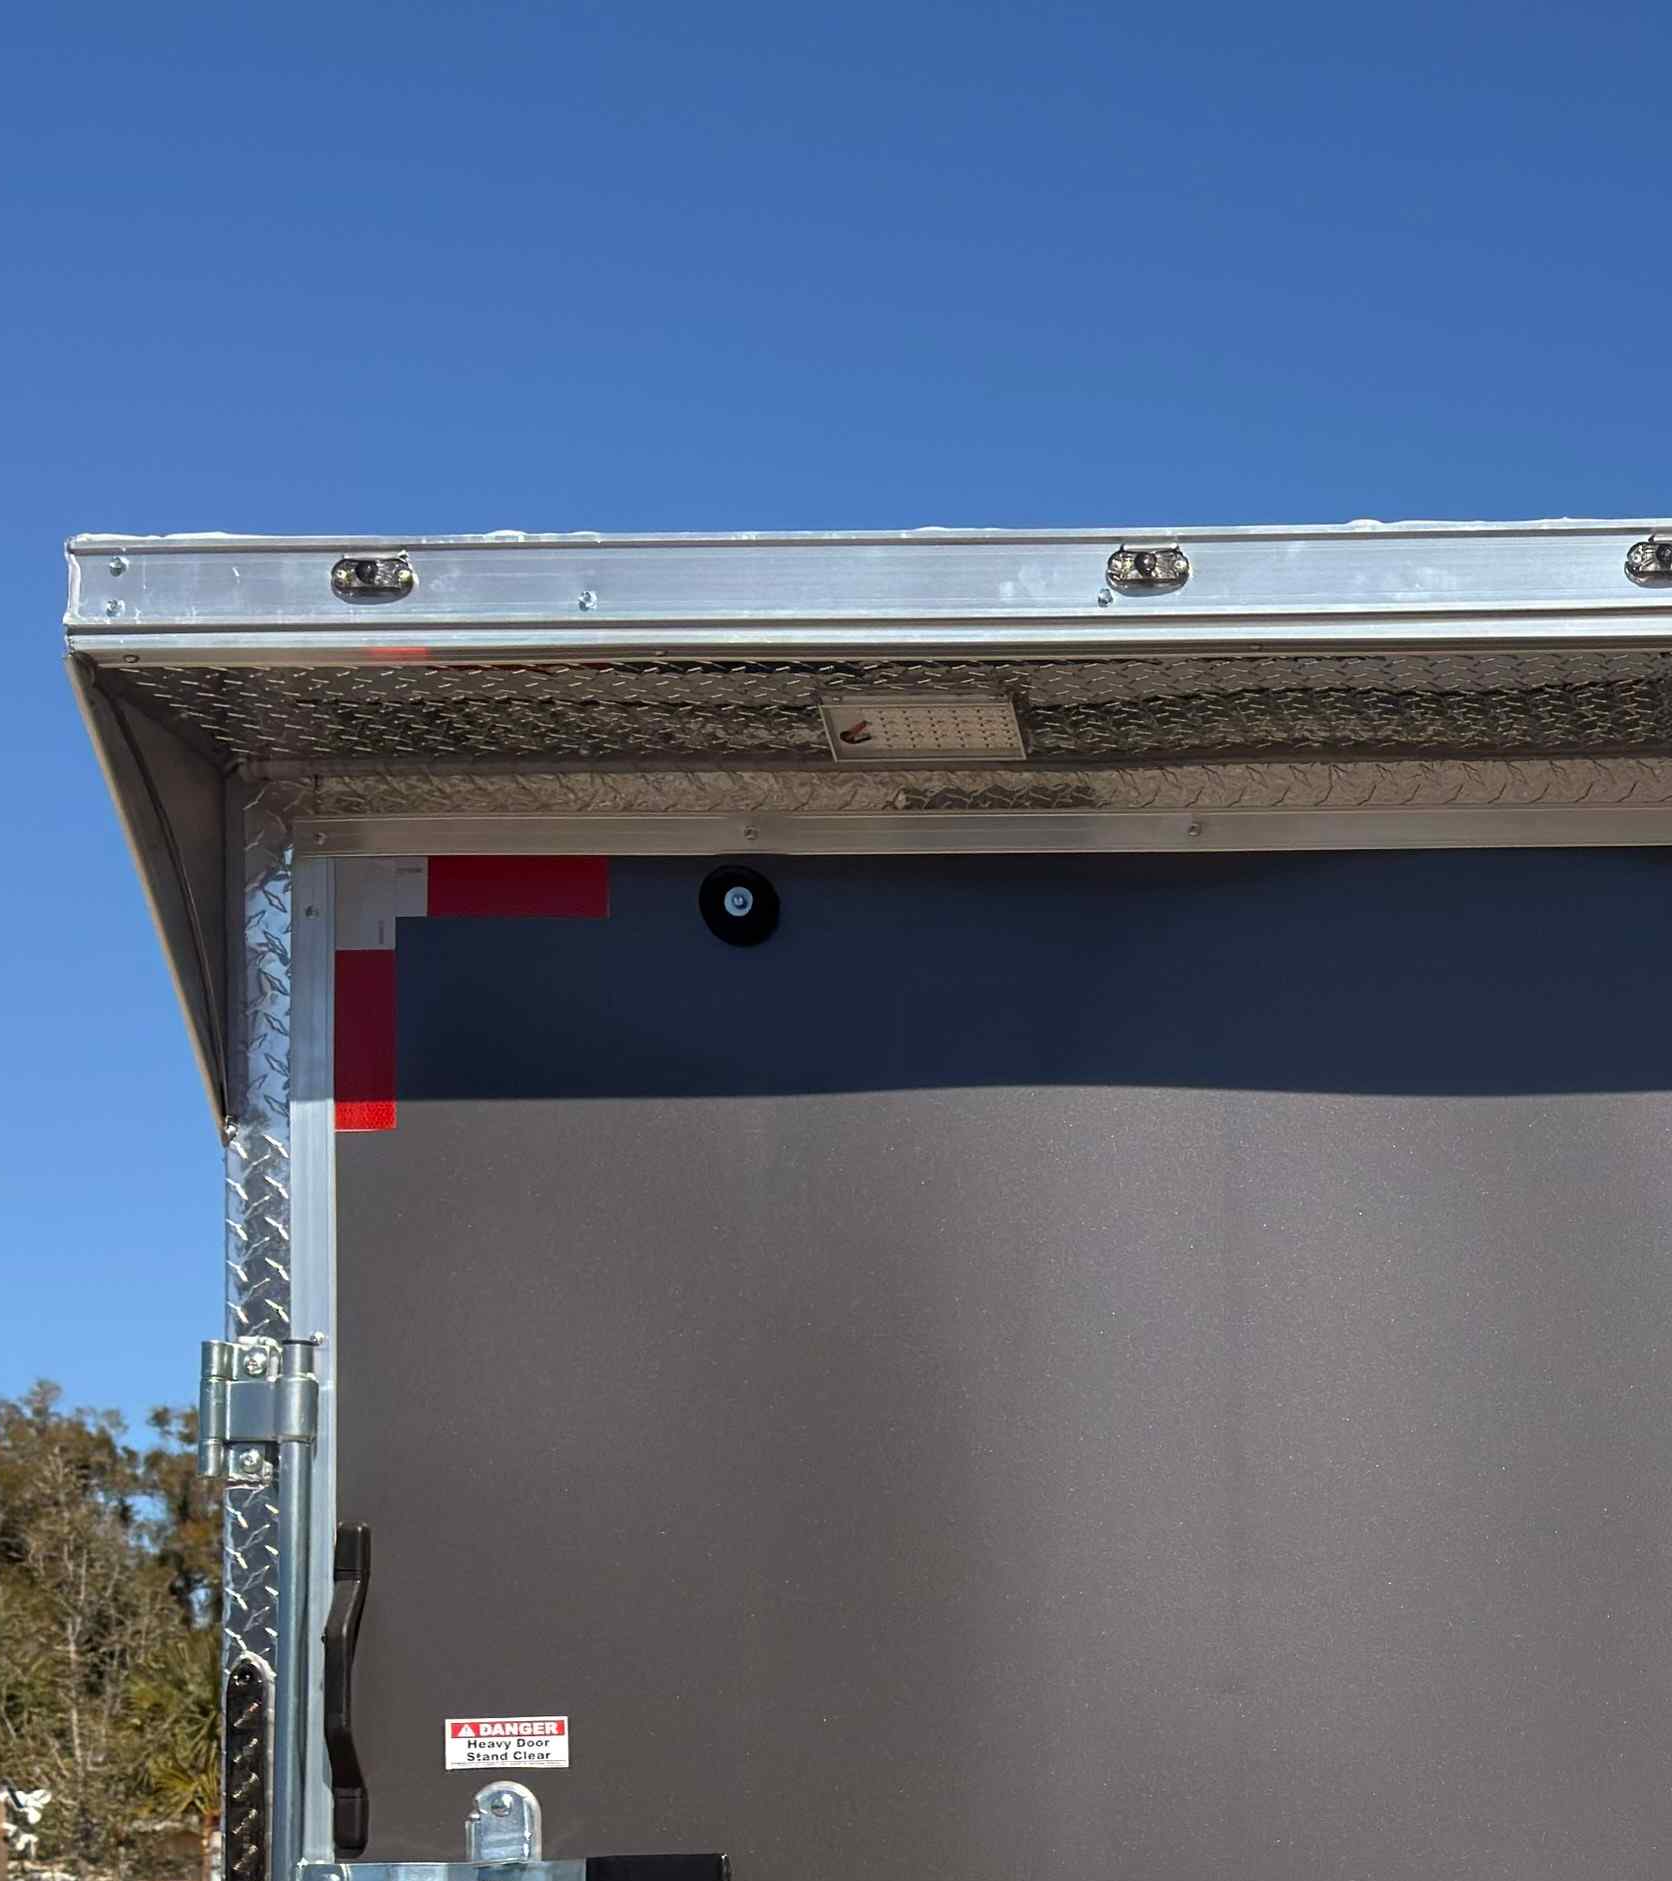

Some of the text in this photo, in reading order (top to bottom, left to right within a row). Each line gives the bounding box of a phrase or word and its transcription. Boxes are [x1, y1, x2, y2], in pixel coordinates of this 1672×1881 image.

[478, 1721, 557, 1737] DANGER
[467, 1738, 550, 1750] Heavy Door
[467, 1751, 551, 1761] Stand Clear
